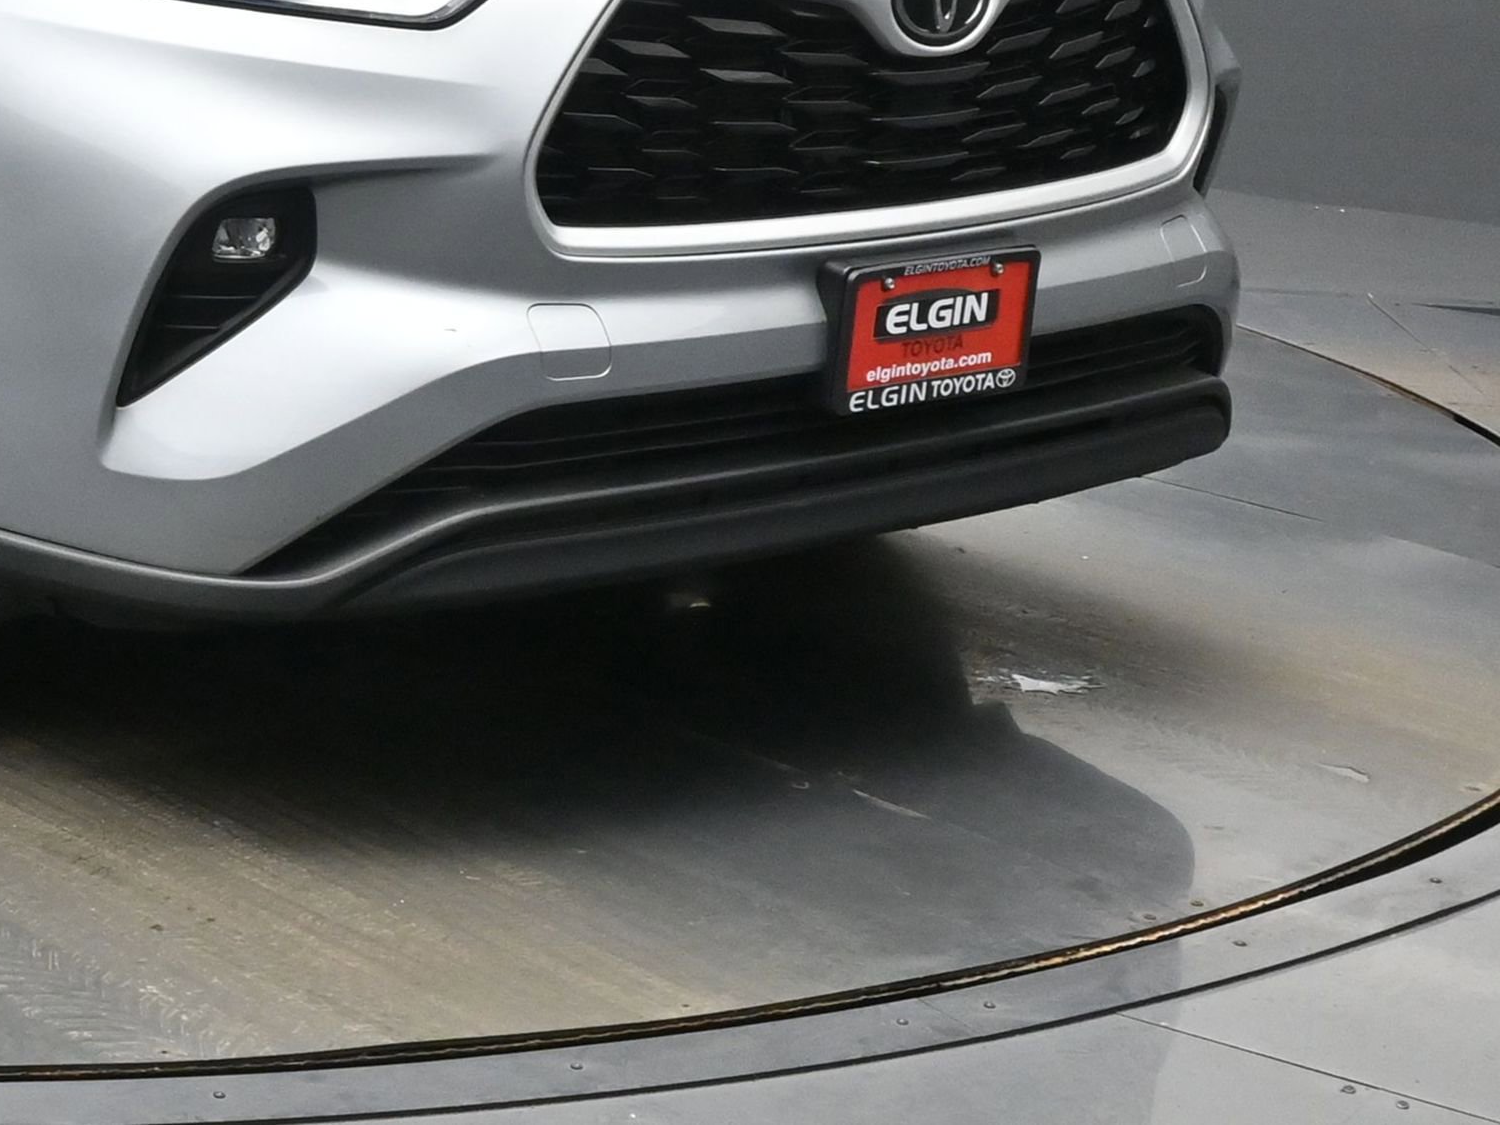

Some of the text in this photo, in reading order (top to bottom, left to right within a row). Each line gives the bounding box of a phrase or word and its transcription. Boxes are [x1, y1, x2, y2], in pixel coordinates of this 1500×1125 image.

[904, 257, 990, 275] ELGINTOYOTA.COM
[885, 292, 989, 335] ELGIN
[901, 335, 964, 357] TOYOTA
[866, 352, 992, 383] elgintoyota.com
[849, 373, 995, 413] ELGIN TOYOTA
